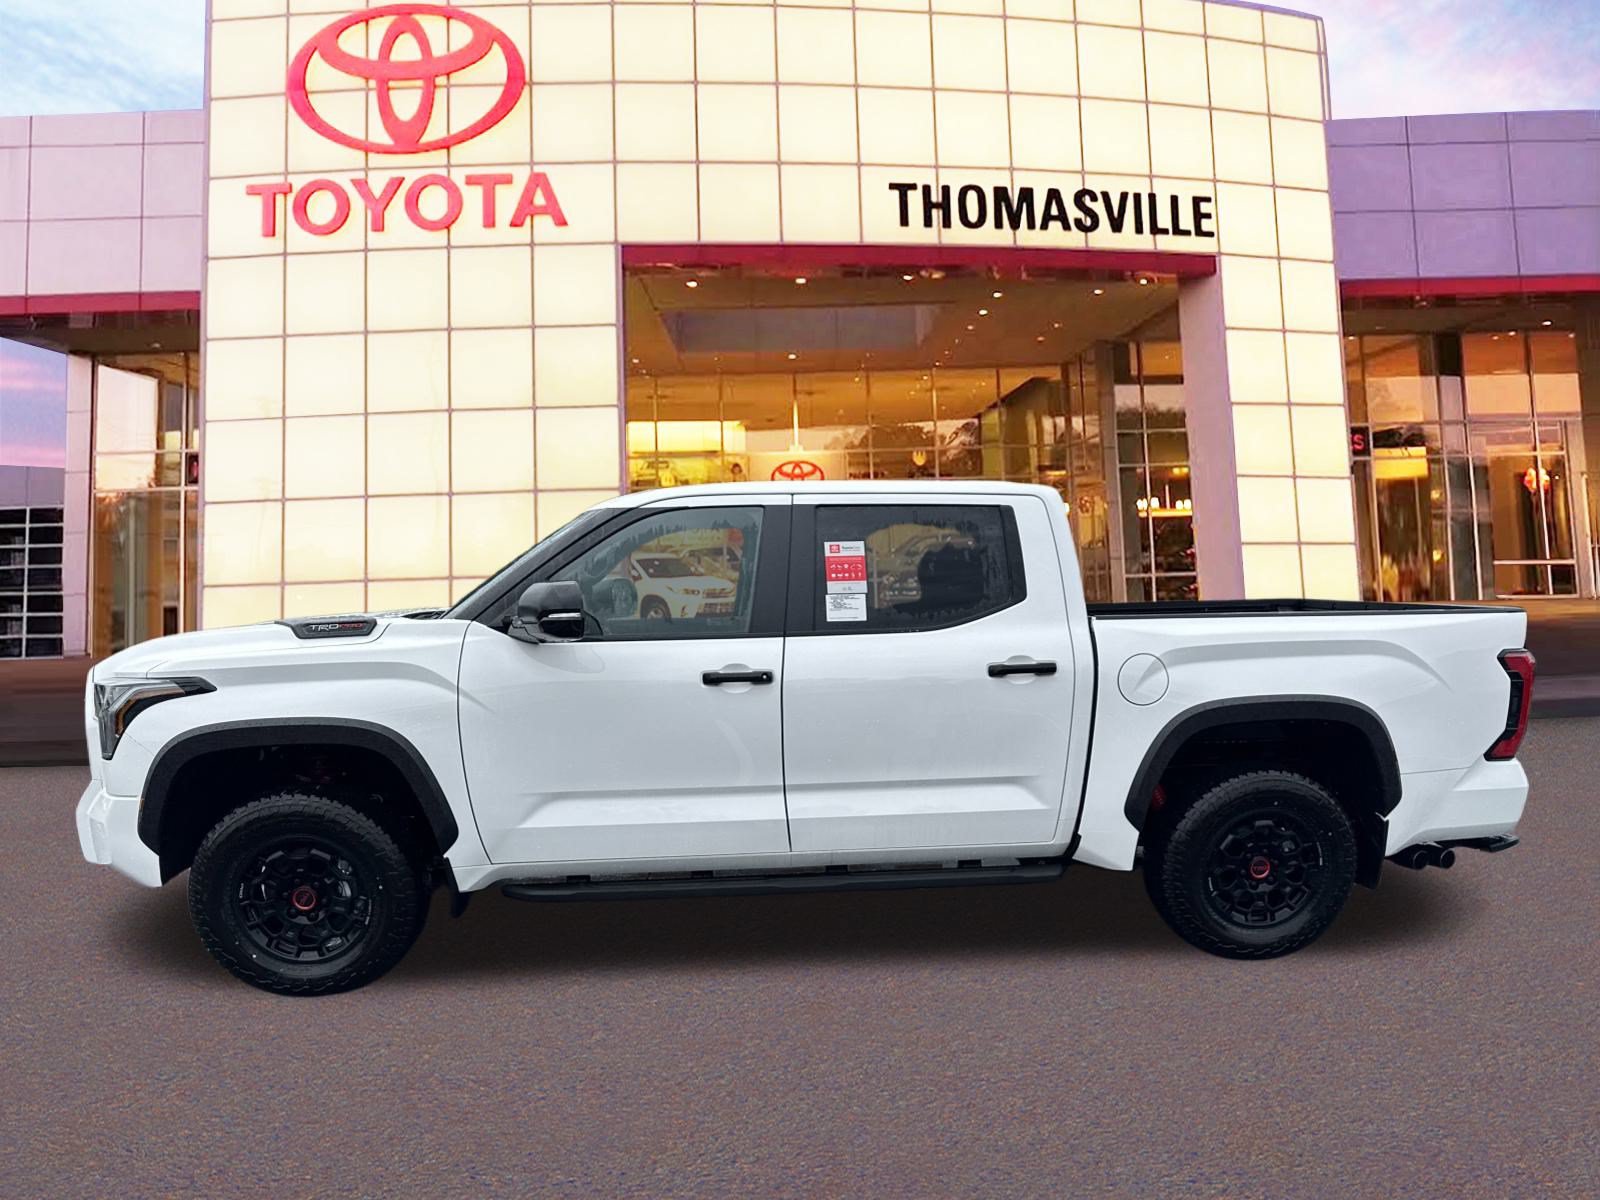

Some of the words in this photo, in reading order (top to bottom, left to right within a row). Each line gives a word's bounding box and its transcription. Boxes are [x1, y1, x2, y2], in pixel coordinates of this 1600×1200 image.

[246, 172, 568, 237] TOYOTA
[888, 182, 1216, 238] THOMASVILLE
[310, 624, 339, 632] TRD
